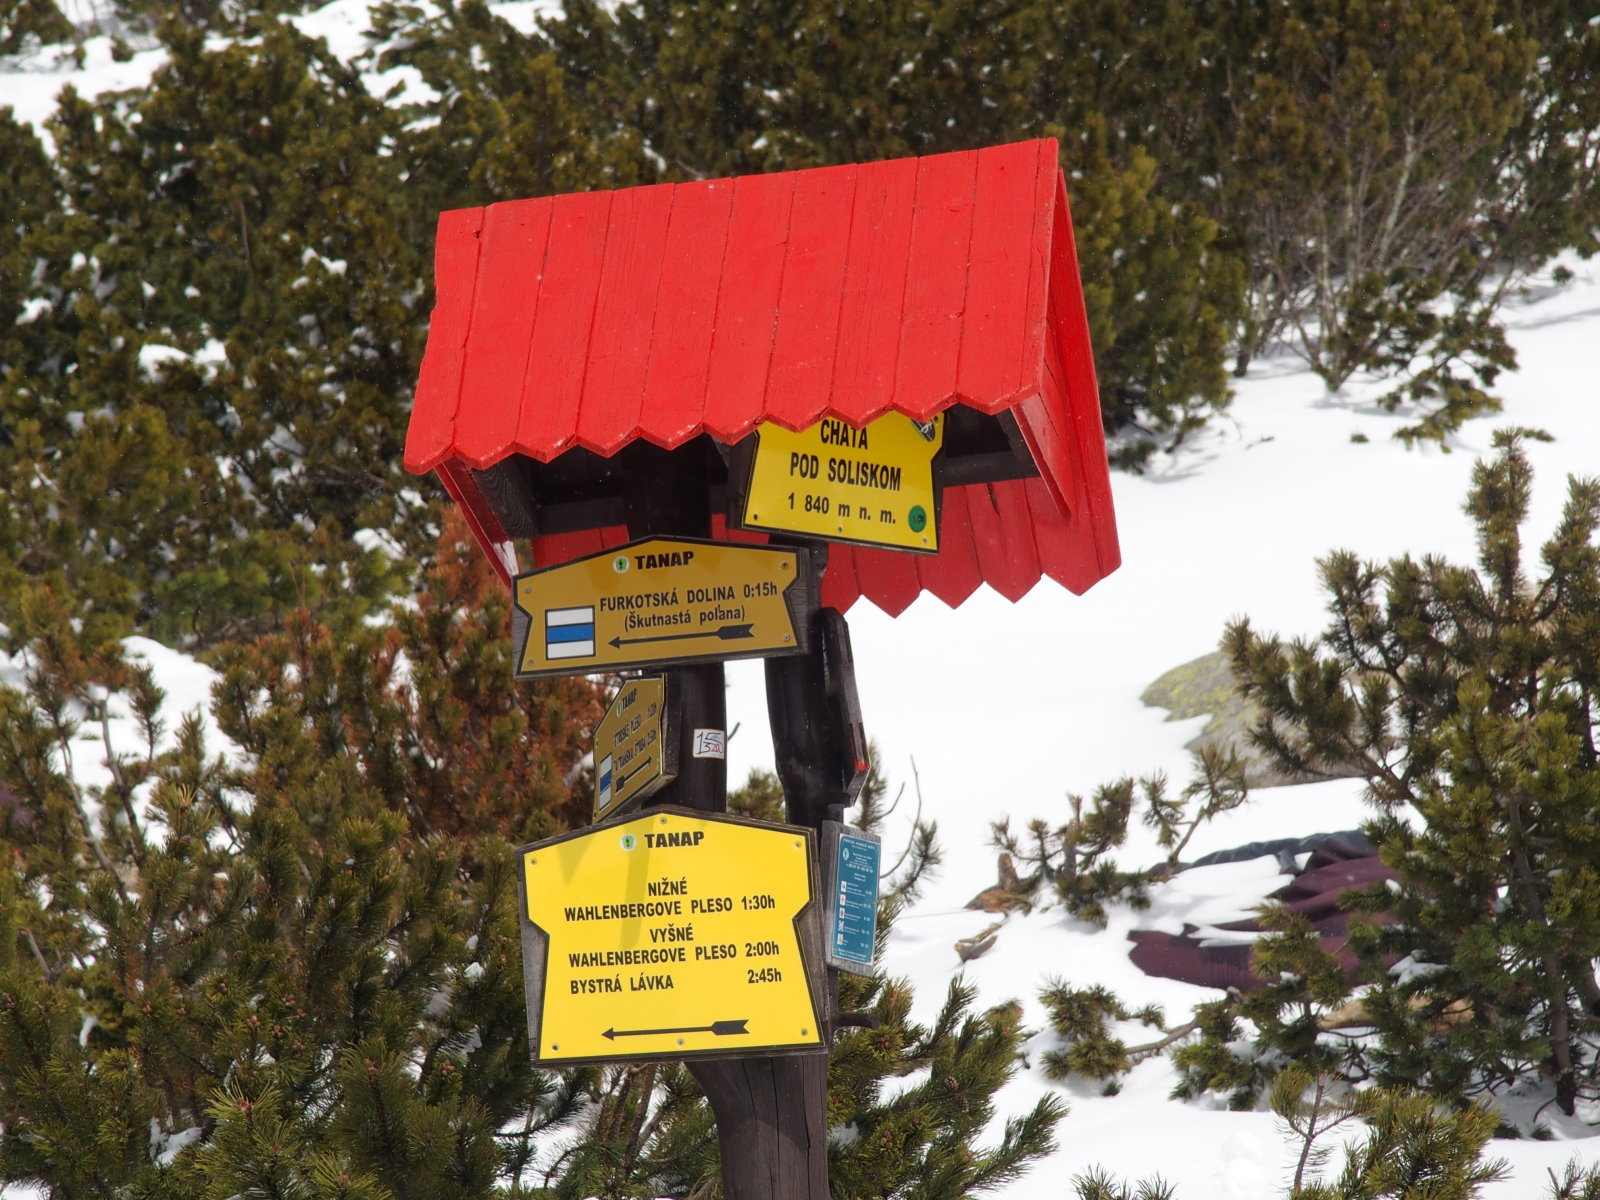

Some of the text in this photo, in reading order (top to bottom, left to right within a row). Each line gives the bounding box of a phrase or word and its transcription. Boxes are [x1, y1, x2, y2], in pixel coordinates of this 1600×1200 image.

[820, 419, 868, 450] CHATA
[790, 452, 902, 492] POD SOLISKOM
[788, 492, 795, 510] 1
[804, 494, 830, 515] 840
[838, 503, 850, 518] m
[859, 506, 871, 521] n.
[880, 509, 897, 525] m.
[634, 551, 695, 570] TANAP
[600, 581, 778, 612] FURKOTSKÁ DOLINA 0:15h
[624, 609, 692, 633] (Škutnastá
[644, 831, 705, 849] TANAP
[647, 876, 688, 897] NIŽNÉ
[564, 894, 776, 922] WAHLENBERGOVE PLESO 1:30h
[649, 922, 694, 943] VYŠNÉ
[568, 941, 780, 968] WAHLENBERGOVE PLESO 2:00h
[570, 972, 674, 995] BYSTRÁ LÁVKA
[747, 968, 782, 984] 2:45h
